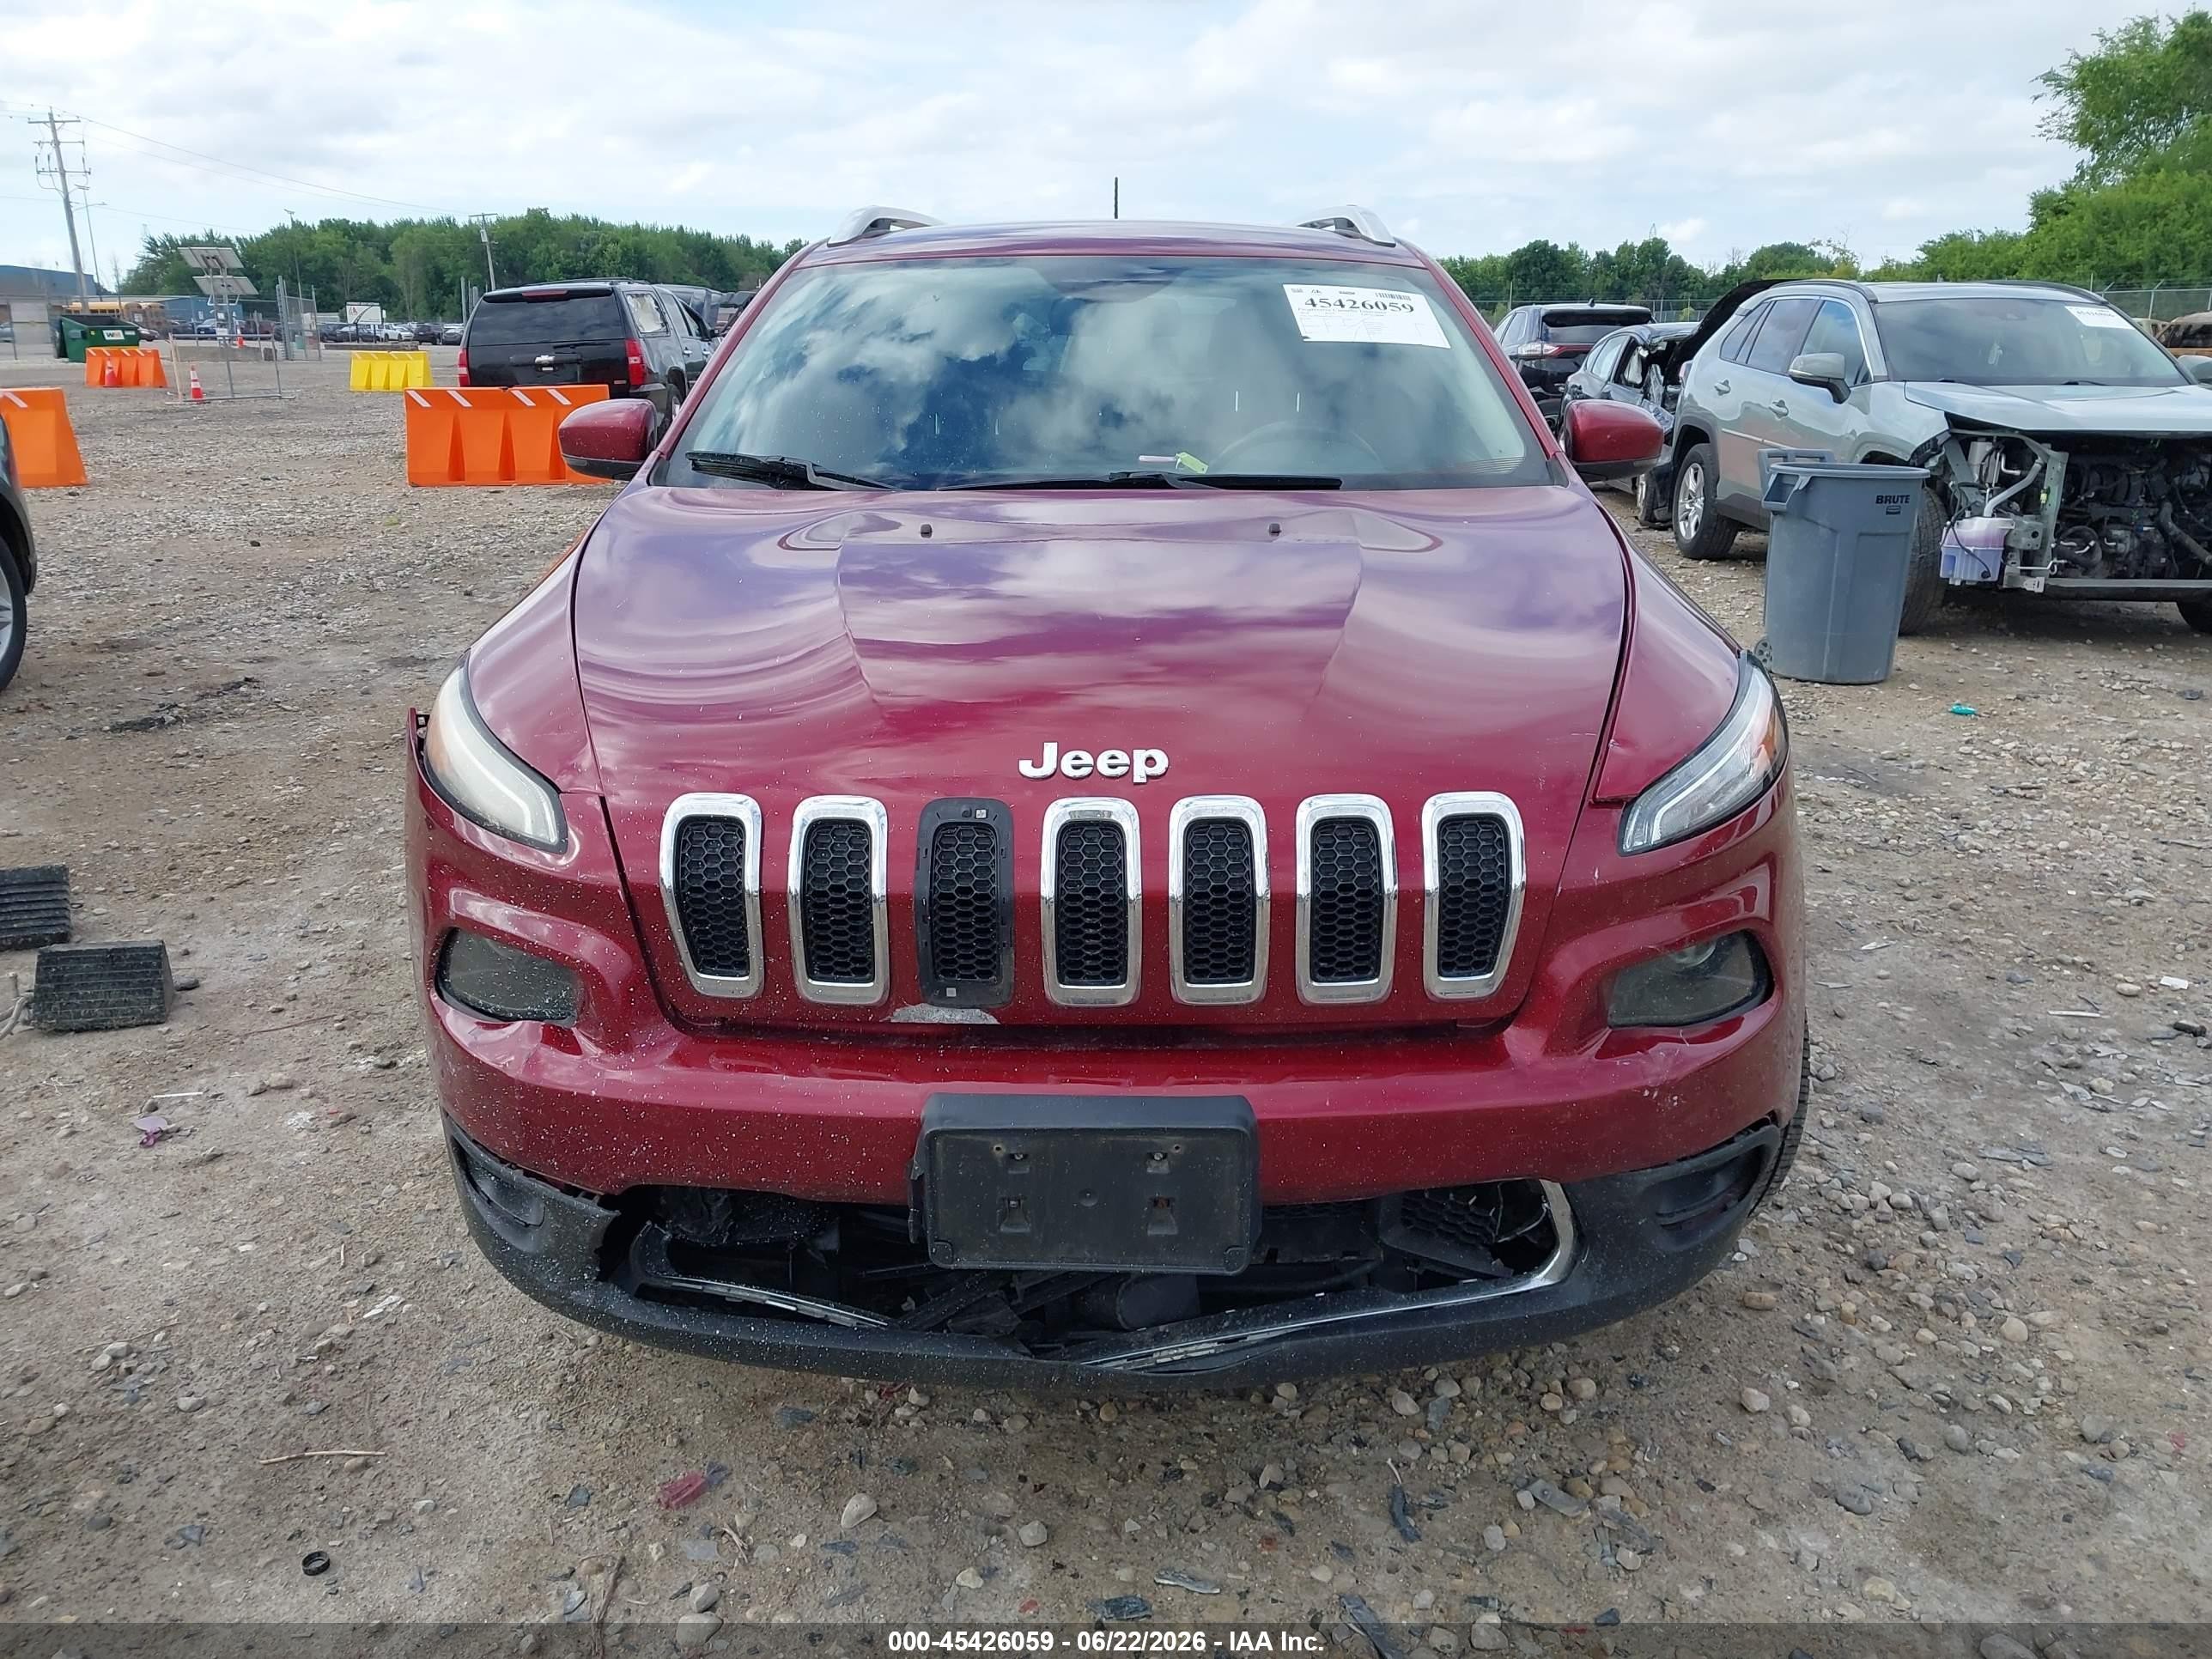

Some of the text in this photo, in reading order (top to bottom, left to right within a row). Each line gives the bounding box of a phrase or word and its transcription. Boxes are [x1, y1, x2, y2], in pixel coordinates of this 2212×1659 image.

[1304, 297, 1414, 313] 45426059
[1875, 495, 1911, 504] BRUTE
[1018, 742, 1169, 783] Jeep
